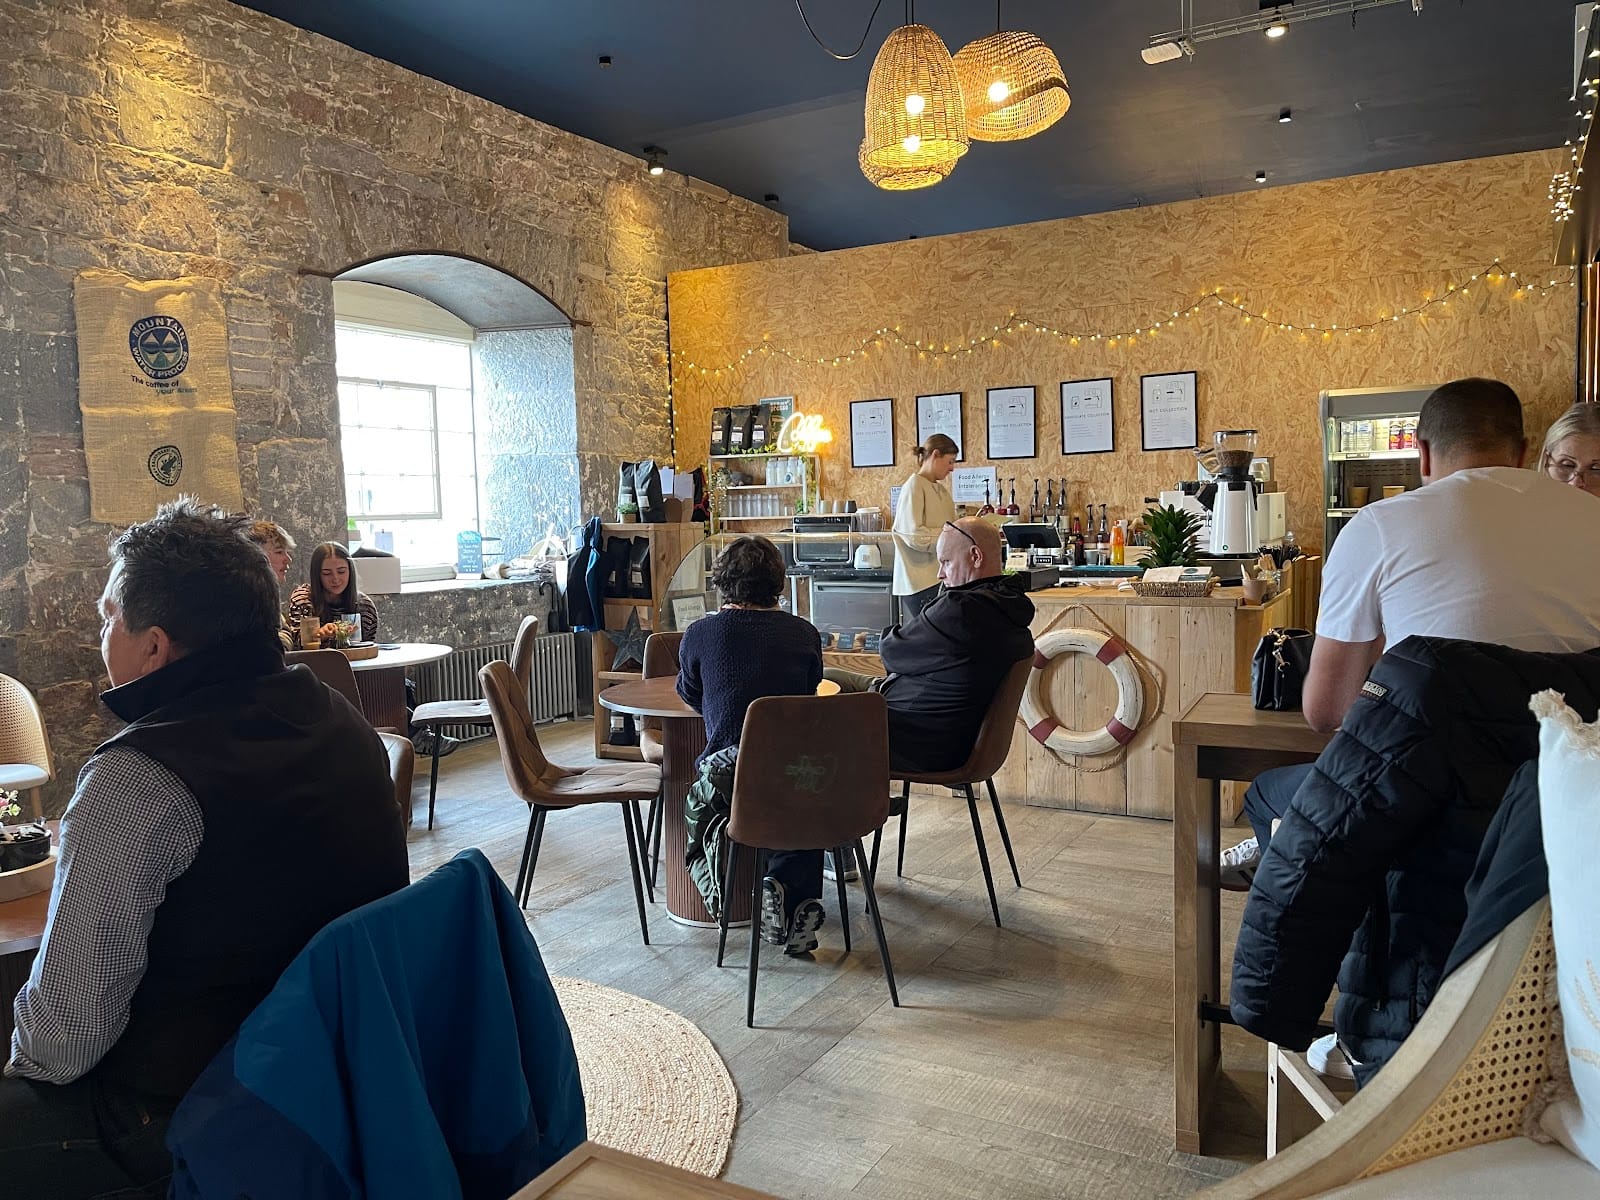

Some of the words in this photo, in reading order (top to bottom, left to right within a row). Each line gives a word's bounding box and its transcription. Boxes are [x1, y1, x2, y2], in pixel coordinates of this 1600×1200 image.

[131, 317, 186, 340] MOUNTAIN
[132, 347, 156, 377] WATER
[157, 351, 188, 378] PROCESS
[131, 374, 144, 385] The
[171, 379, 179, 387] of
[777, 411, 832, 452] Coff
